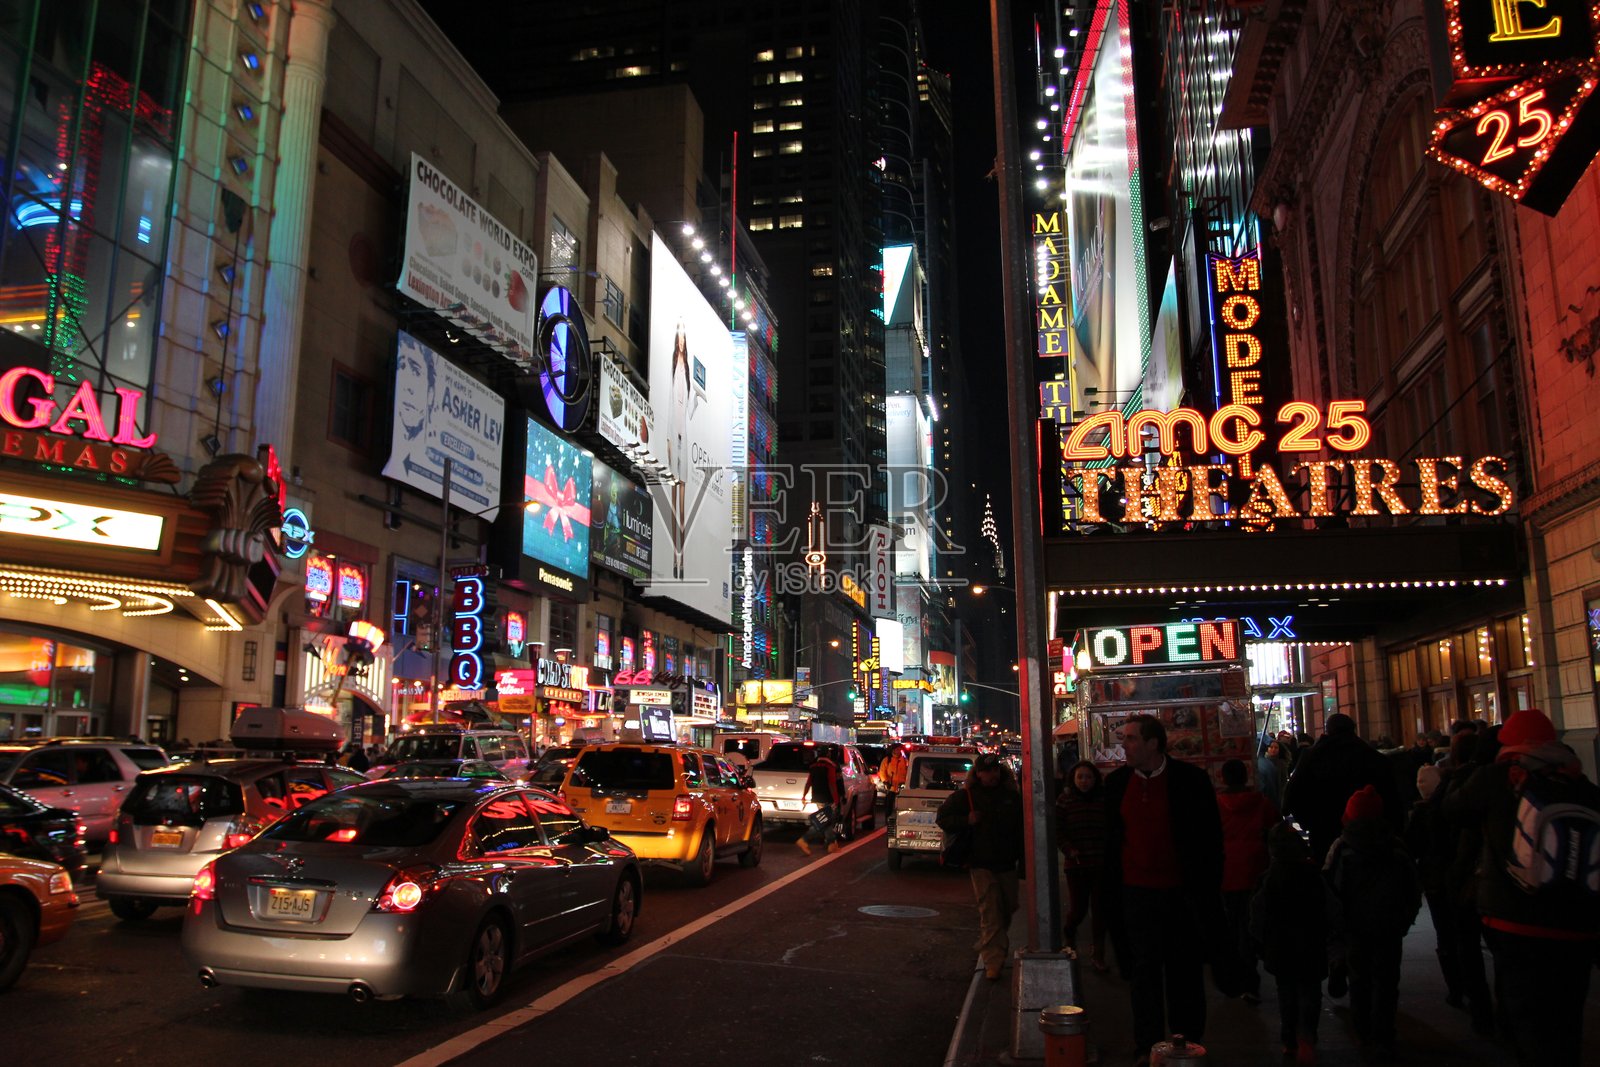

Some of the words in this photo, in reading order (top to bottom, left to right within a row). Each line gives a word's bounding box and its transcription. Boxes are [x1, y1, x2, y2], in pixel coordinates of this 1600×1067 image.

[1476, 88, 1553, 166] 25
[416, 160, 477, 224] CHOCOLATE
[479, 209, 511, 252] WORLD
[512, 240, 536, 271] EXPO
[1036, 212, 1065, 355] MADAME
[602, 356, 629, 396] CHOCOLATE
[629, 384, 644, 412] WORLD
[442, 386, 481, 433] ASHER
[483, 412, 503, 446] LEV
[1276, 400, 1372, 453] 25
[2, 430, 128, 474] EMAS
[1066, 455, 1513, 525] THEATRES
[538, 567, 574, 592] Panasonic
[876, 531, 887, 610] RICOH
[452, 577, 484, 691] BBQ
[1093, 621, 1237, 667] OPEN
[537, 657, 562, 687] COLD
